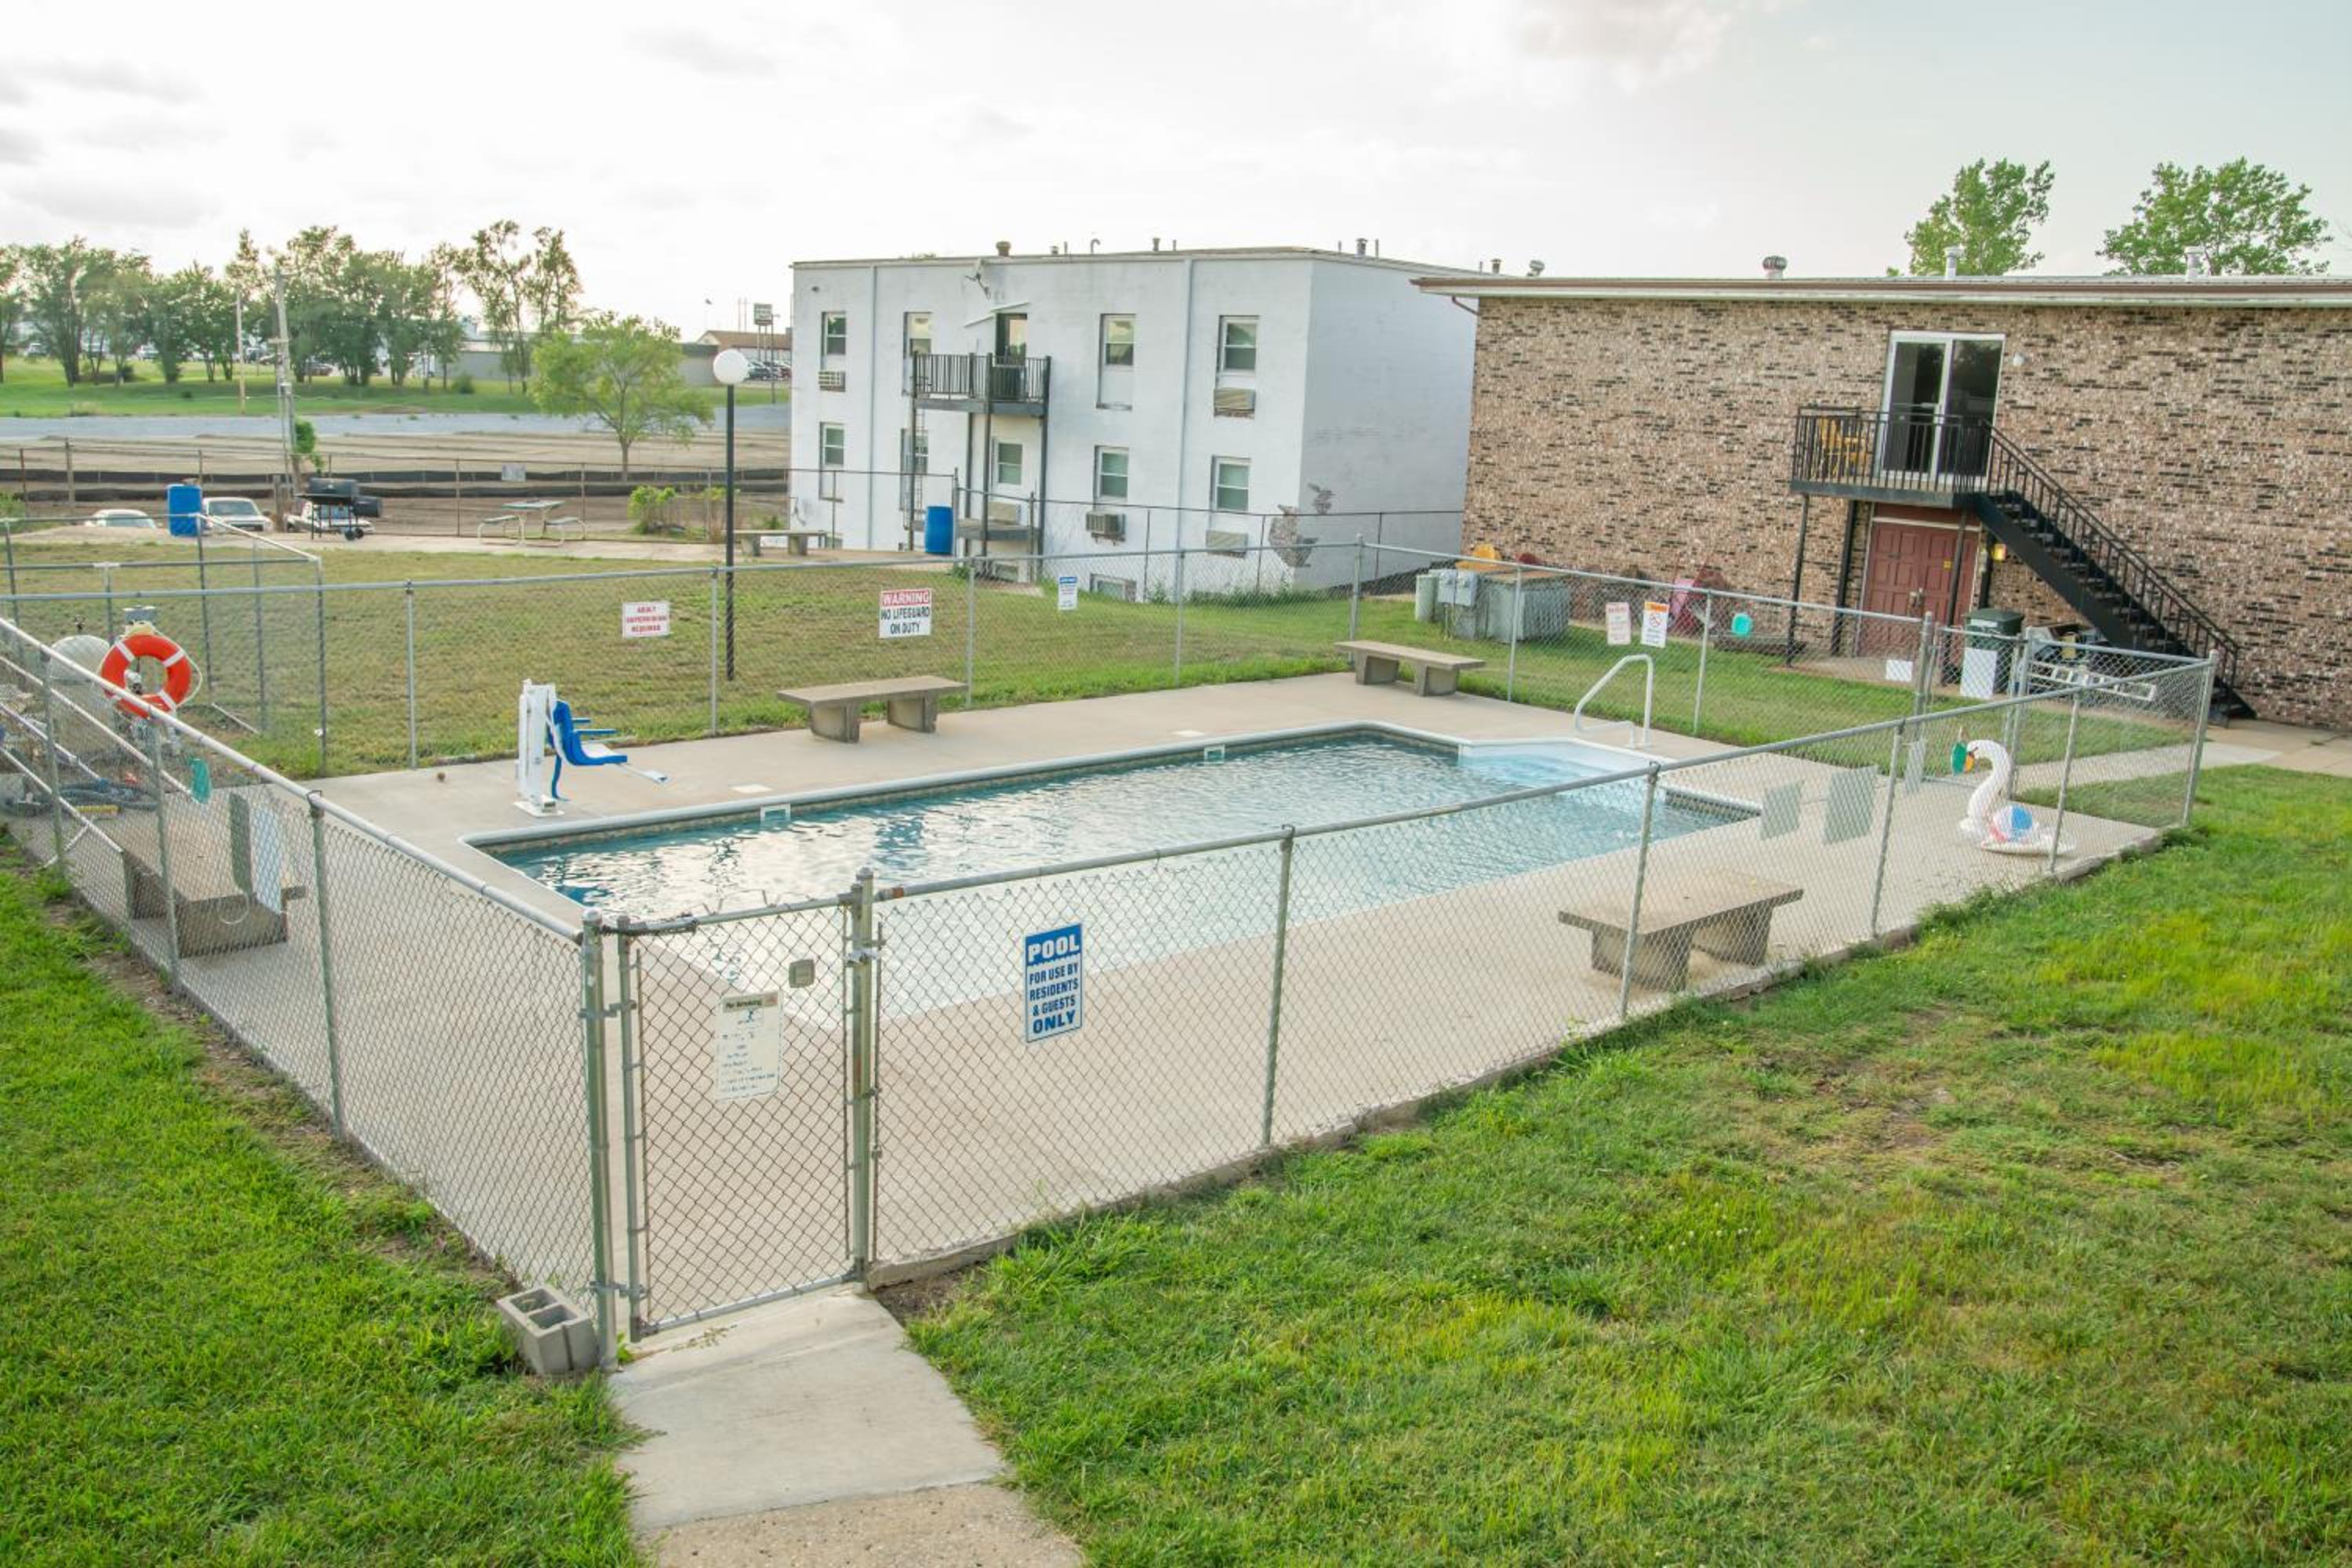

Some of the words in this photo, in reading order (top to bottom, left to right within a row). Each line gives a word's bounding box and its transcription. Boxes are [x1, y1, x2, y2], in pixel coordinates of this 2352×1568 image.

[883, 593, 928, 604] WARNING
[880, 609, 891, 619] NO
[893, 606, 929, 619] LIFEGUARD
[890, 622, 901, 633] ON
[902, 622, 920, 633] DUTY
[1028, 934, 1080, 963] POOL
[1029, 971, 1047, 985] FOR
[1048, 965, 1065, 980] USE
[1067, 963, 1079, 975] BY
[1029, 978, 1079, 1001] RESIDENTS
[1033, 1004, 1040, 1017] &
[1041, 995, 1076, 1014] GUESTS
[1033, 1010, 1075, 1034] ONLY
